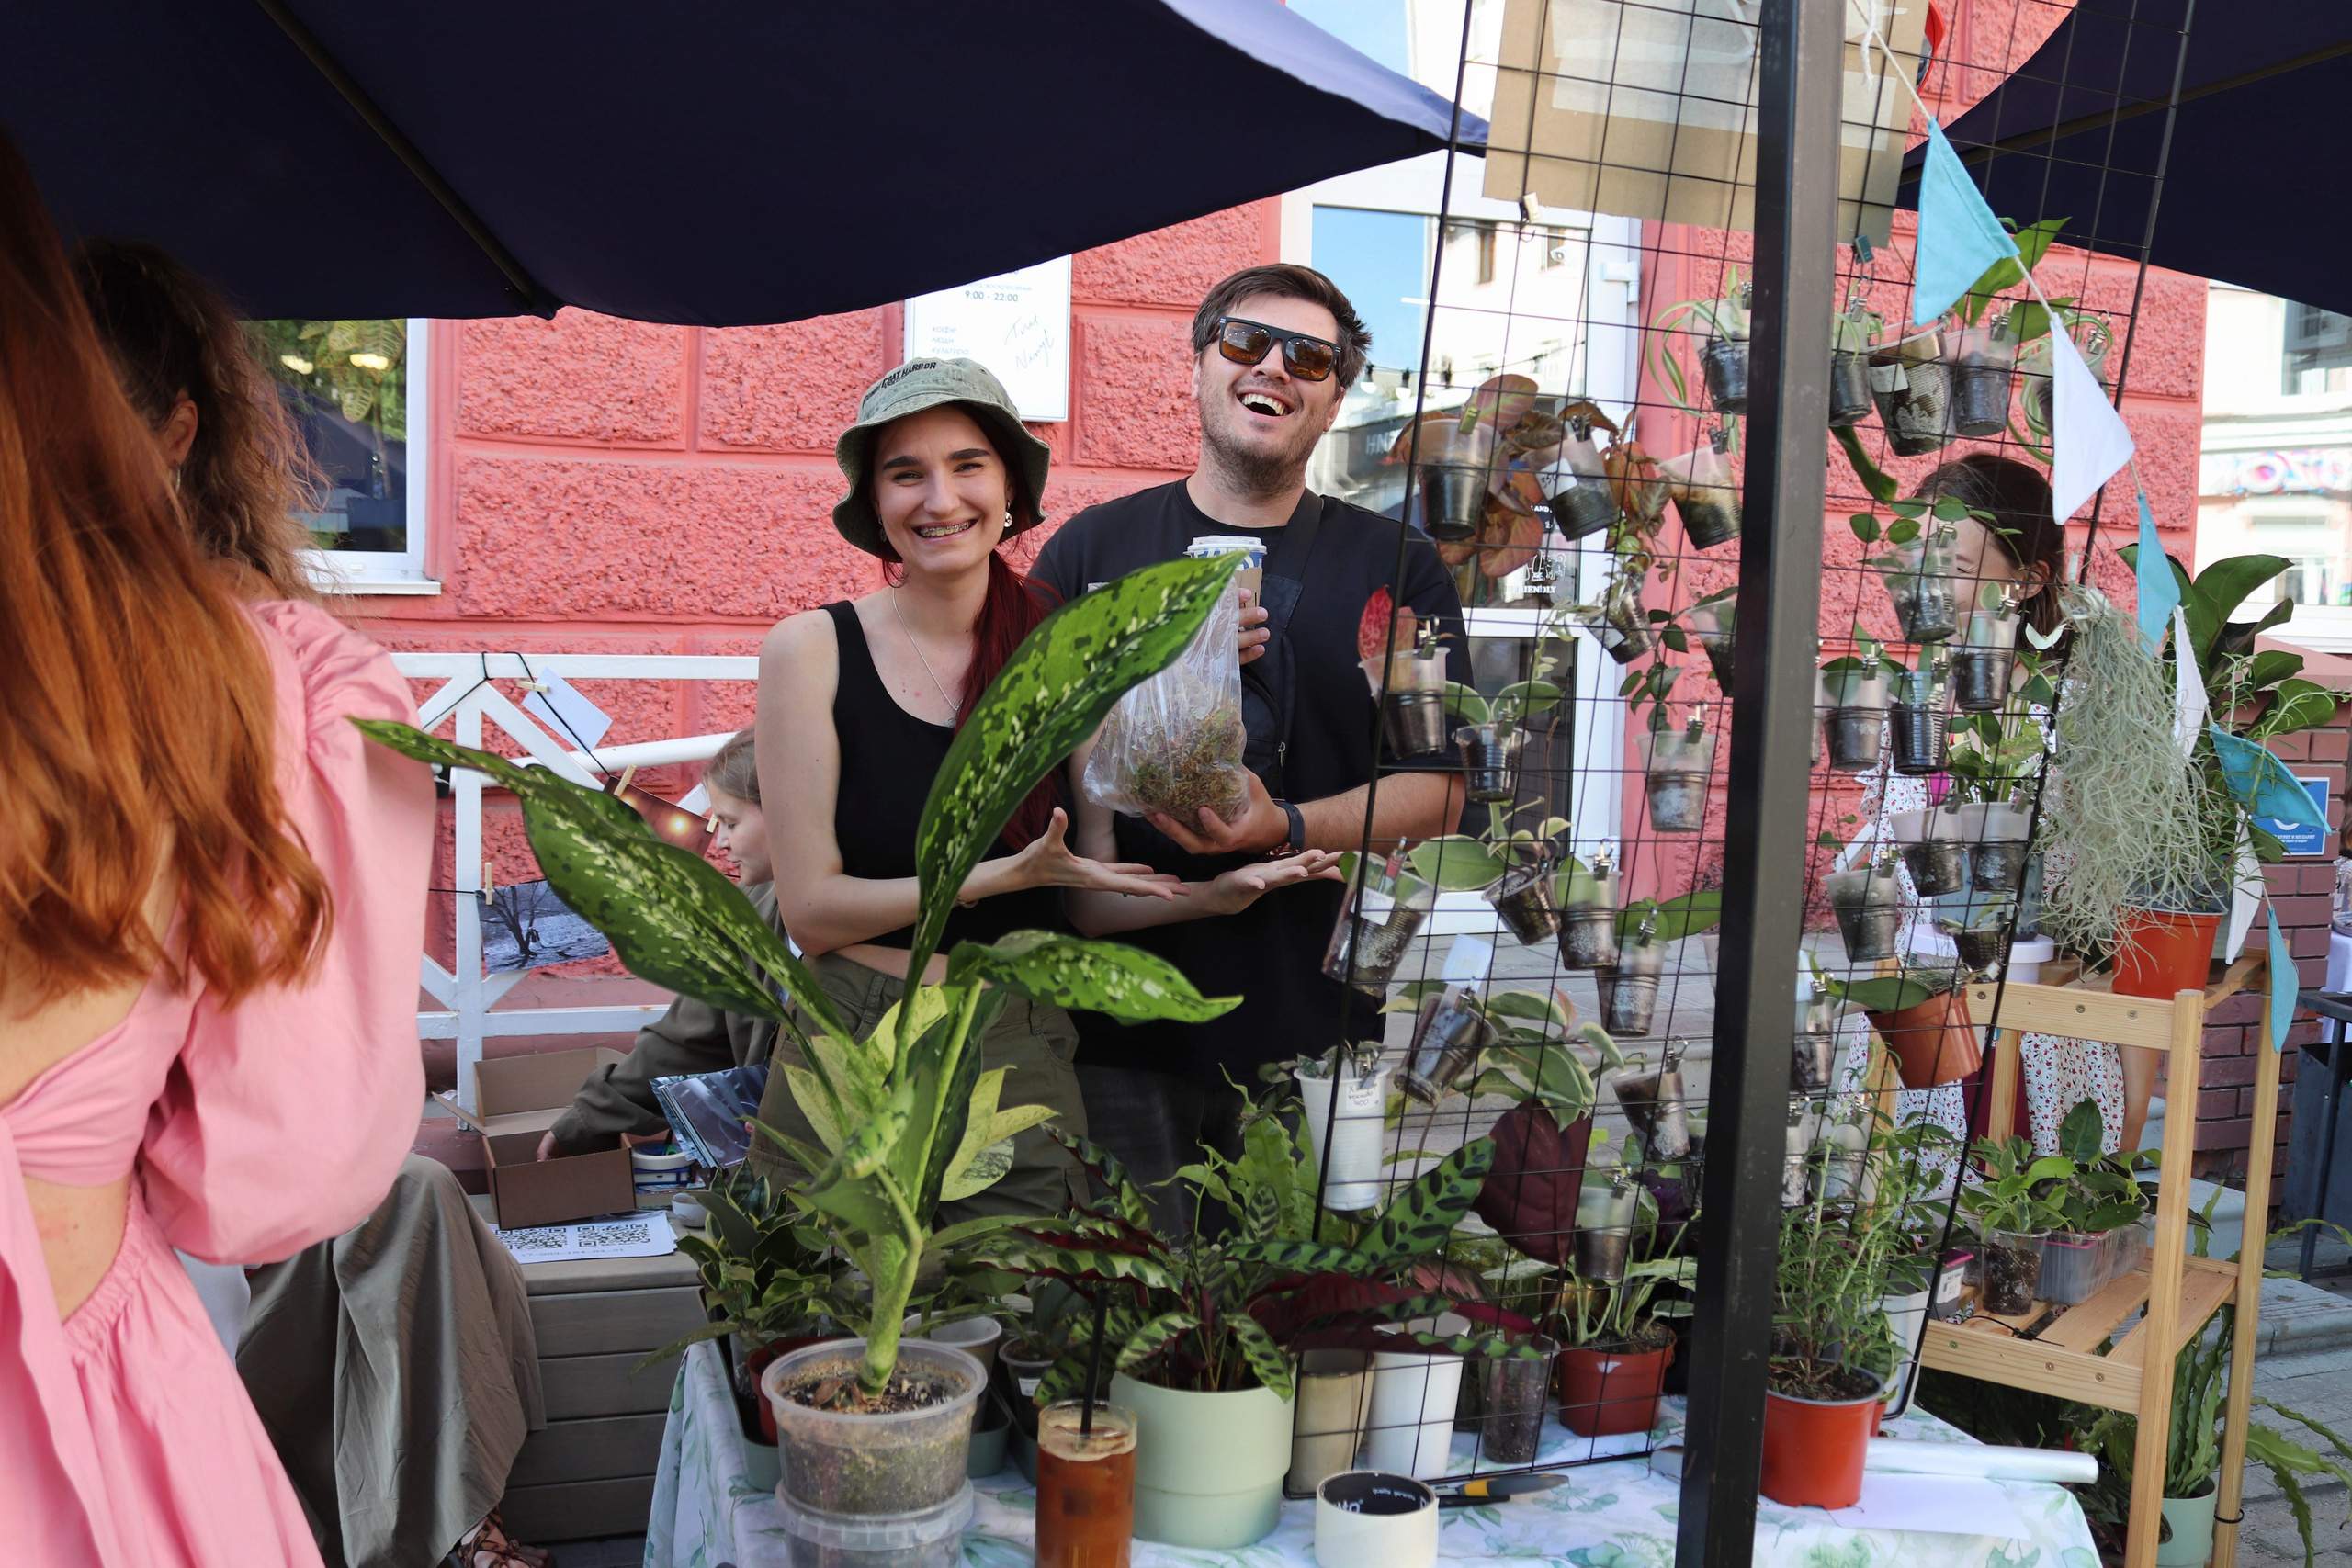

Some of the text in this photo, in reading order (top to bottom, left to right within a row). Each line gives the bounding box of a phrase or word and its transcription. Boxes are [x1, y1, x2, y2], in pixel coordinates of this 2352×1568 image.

[965, 290, 984, 300] 9:00
[993, 292, 1019, 302] 22:00
[932, 325, 957, 334] кофе
[932, 336, 955, 344] люди
[932, 347, 969, 356] культура
